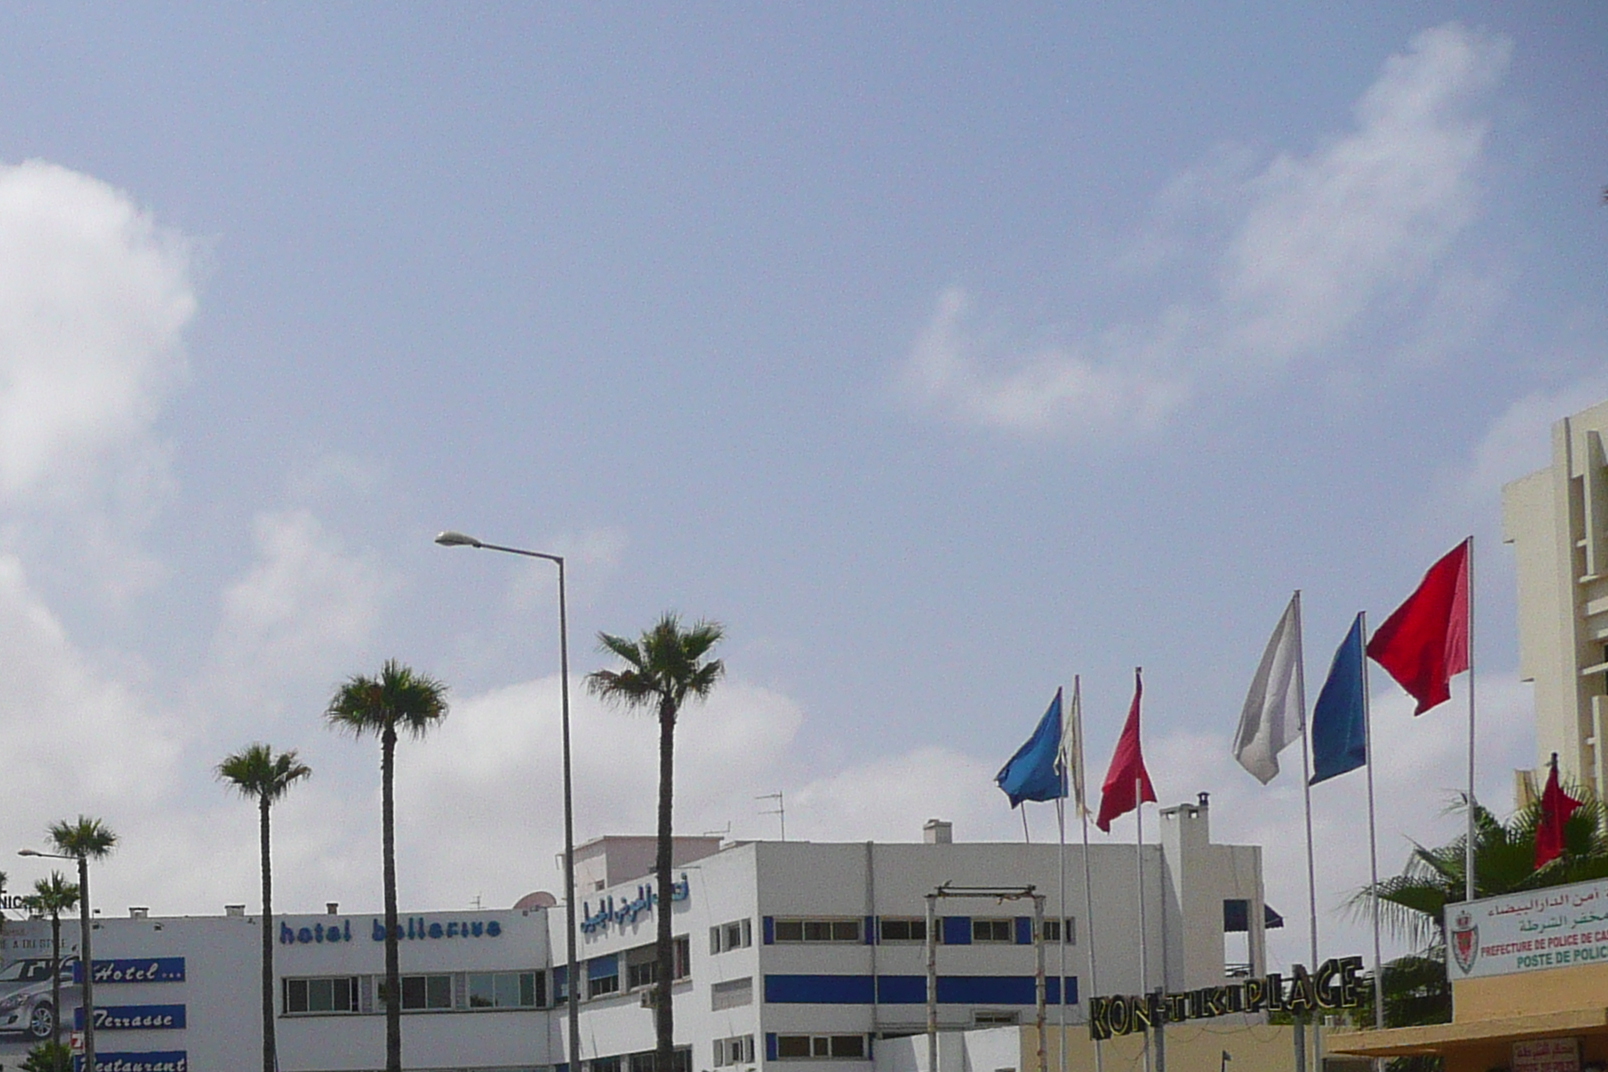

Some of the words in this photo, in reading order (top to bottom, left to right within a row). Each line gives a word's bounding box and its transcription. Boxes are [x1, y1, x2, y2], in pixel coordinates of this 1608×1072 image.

[1573, 887, 1599, 907] أمن
[280, 919, 351, 944] hotel
[1519, 915, 1567, 934] الشرطة
[1481, 940, 1533, 958] PREFECTURE
[1535, 938, 1547, 950] DE
[1548, 934, 1579, 948] POLICE
[1581, 931, 1593, 944] DE
[1517, 953, 1554, 969] POSTE
[1556, 950, 1571, 964] DE
[94, 963, 159, 981] Hotel
[1089, 983, 1243, 1041] KON-TIKI
[1243, 956, 1364, 1014] PLAGE
[93, 1010, 172, 1027] Terrasse
